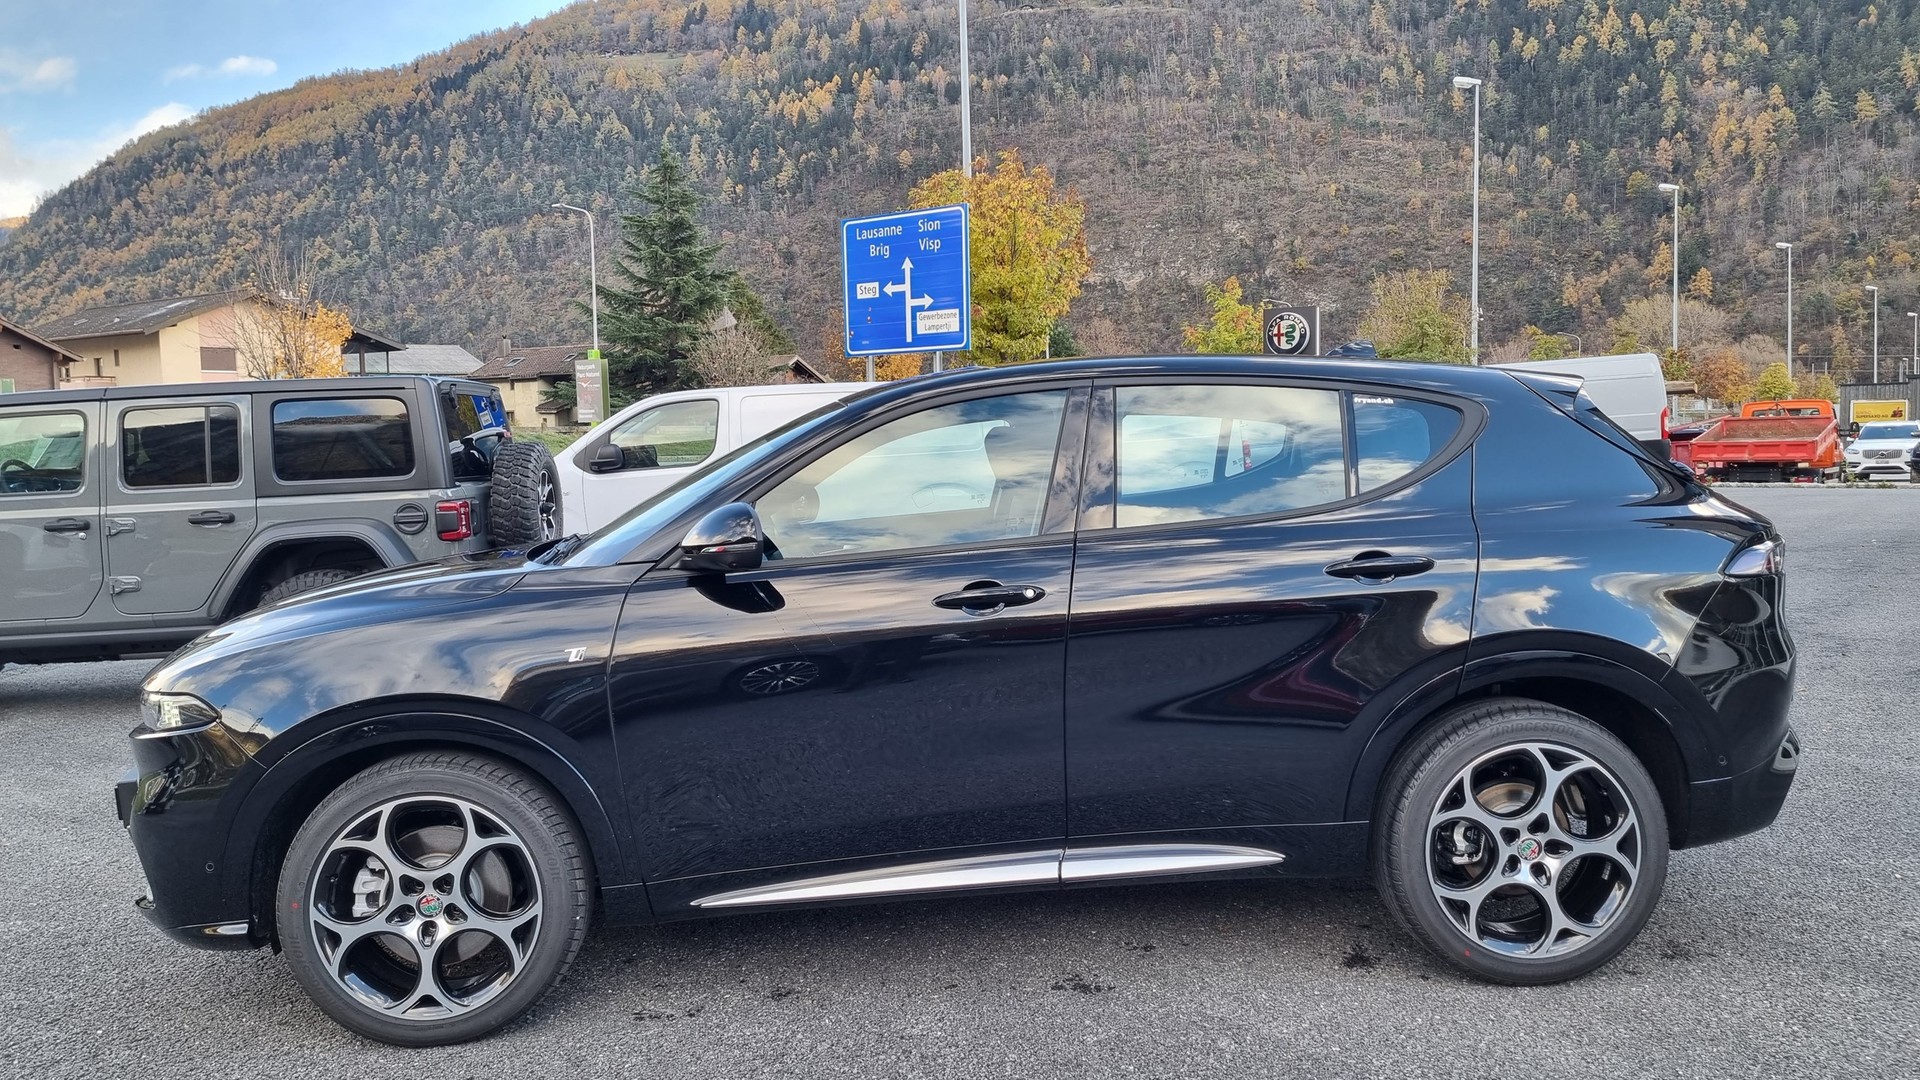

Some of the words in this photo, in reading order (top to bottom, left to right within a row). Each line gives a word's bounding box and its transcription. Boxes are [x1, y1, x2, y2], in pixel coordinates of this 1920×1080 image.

[856, 225, 902, 240] Lausanne
[918, 218, 941, 232] Sion
[869, 243, 890, 258] Brig
[918, 237, 941, 252] Visp
[859, 285, 877, 296] Steg
[918, 311, 958, 321] Gewerbezone
[924, 321, 952, 332] Lampertji
[1269, 318, 1281, 337] ALFA
[1283, 315, 1306, 334] ROMEO
[1489, 722, 1584, 739] BRIDGESTONE
